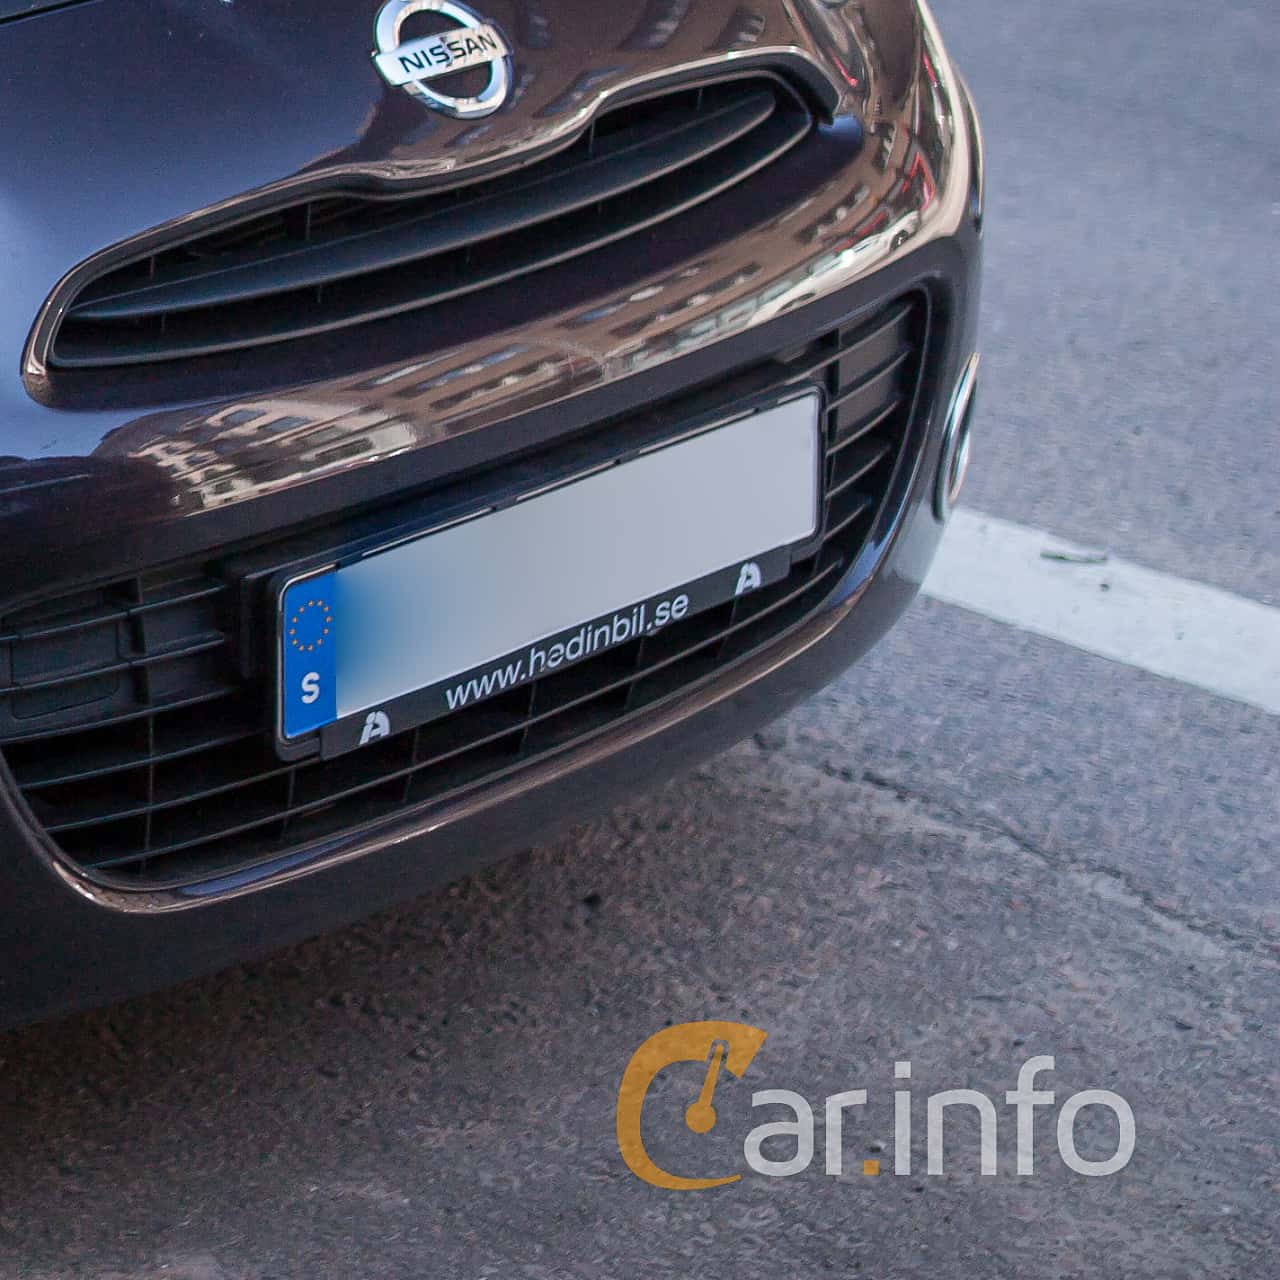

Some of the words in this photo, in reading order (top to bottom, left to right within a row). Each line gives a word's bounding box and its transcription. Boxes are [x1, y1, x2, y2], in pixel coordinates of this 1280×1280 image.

[398, 32, 497, 73] NISSAN
[445, 593, 689, 710] www.hedinbil.se
[301, 671, 320, 704] S
